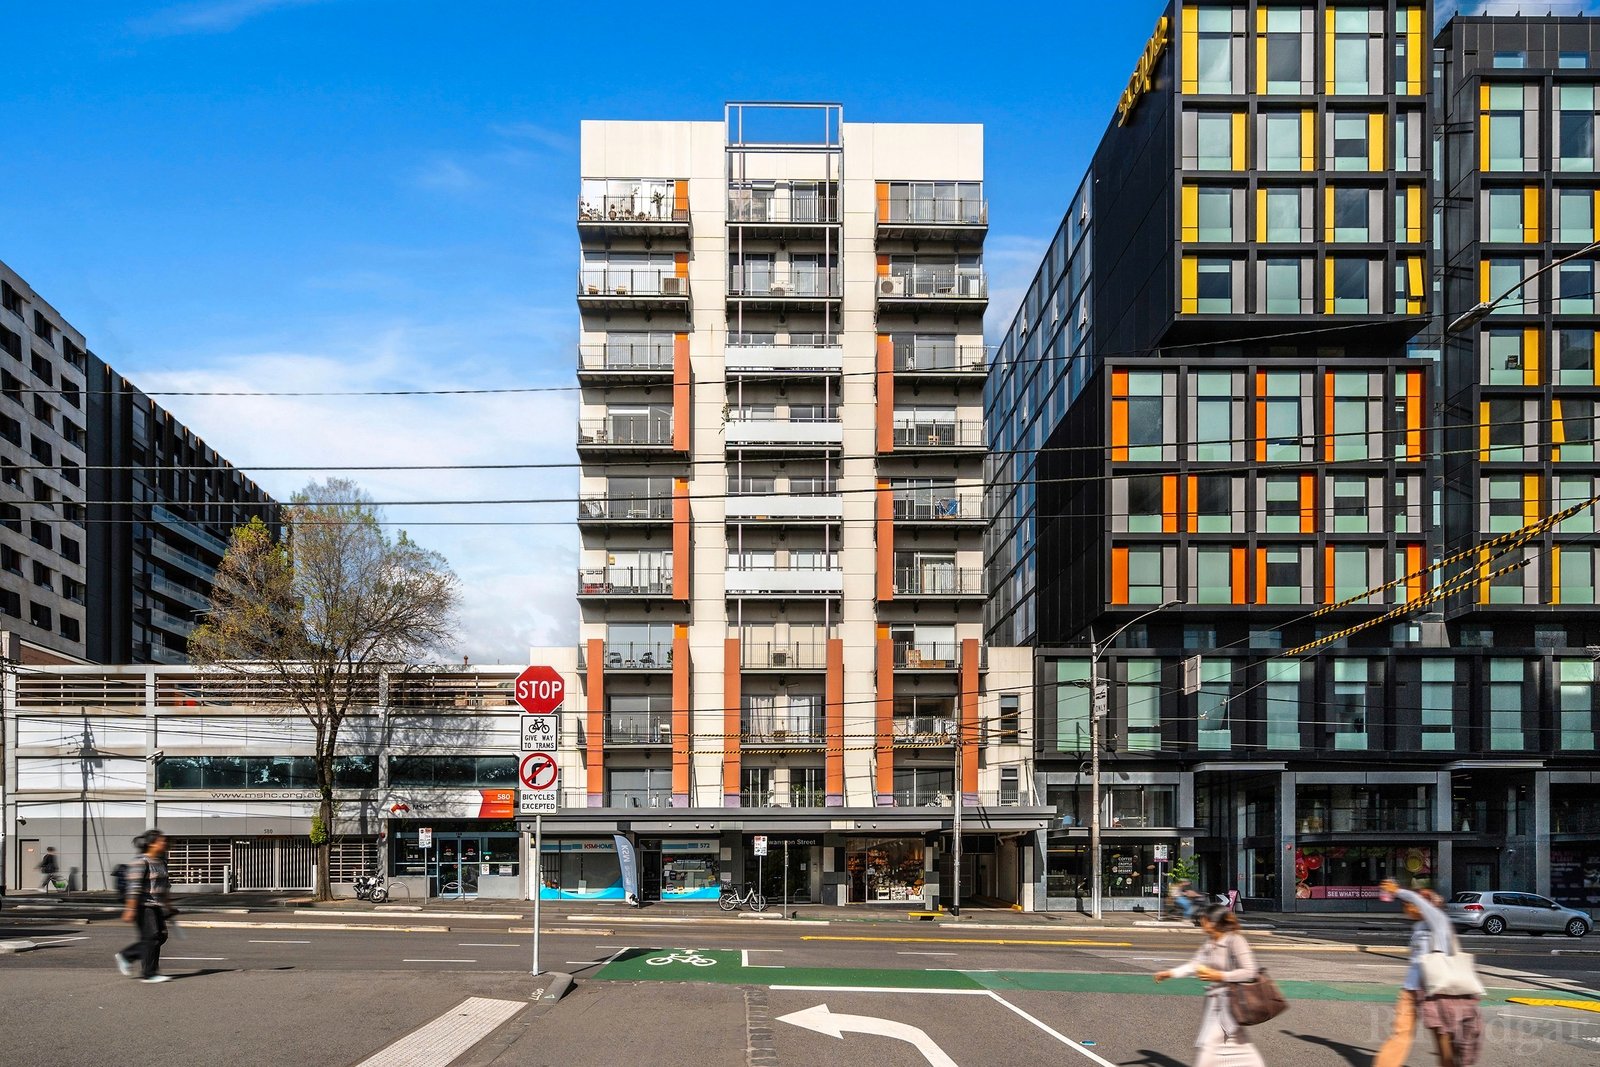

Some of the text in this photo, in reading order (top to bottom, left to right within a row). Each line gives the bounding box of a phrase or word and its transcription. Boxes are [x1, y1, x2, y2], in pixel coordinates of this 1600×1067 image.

[1117, 16, 1168, 128] scape
[518, 680, 562, 699] STOP
[211, 791, 322, 799] www.mshc.org.au
